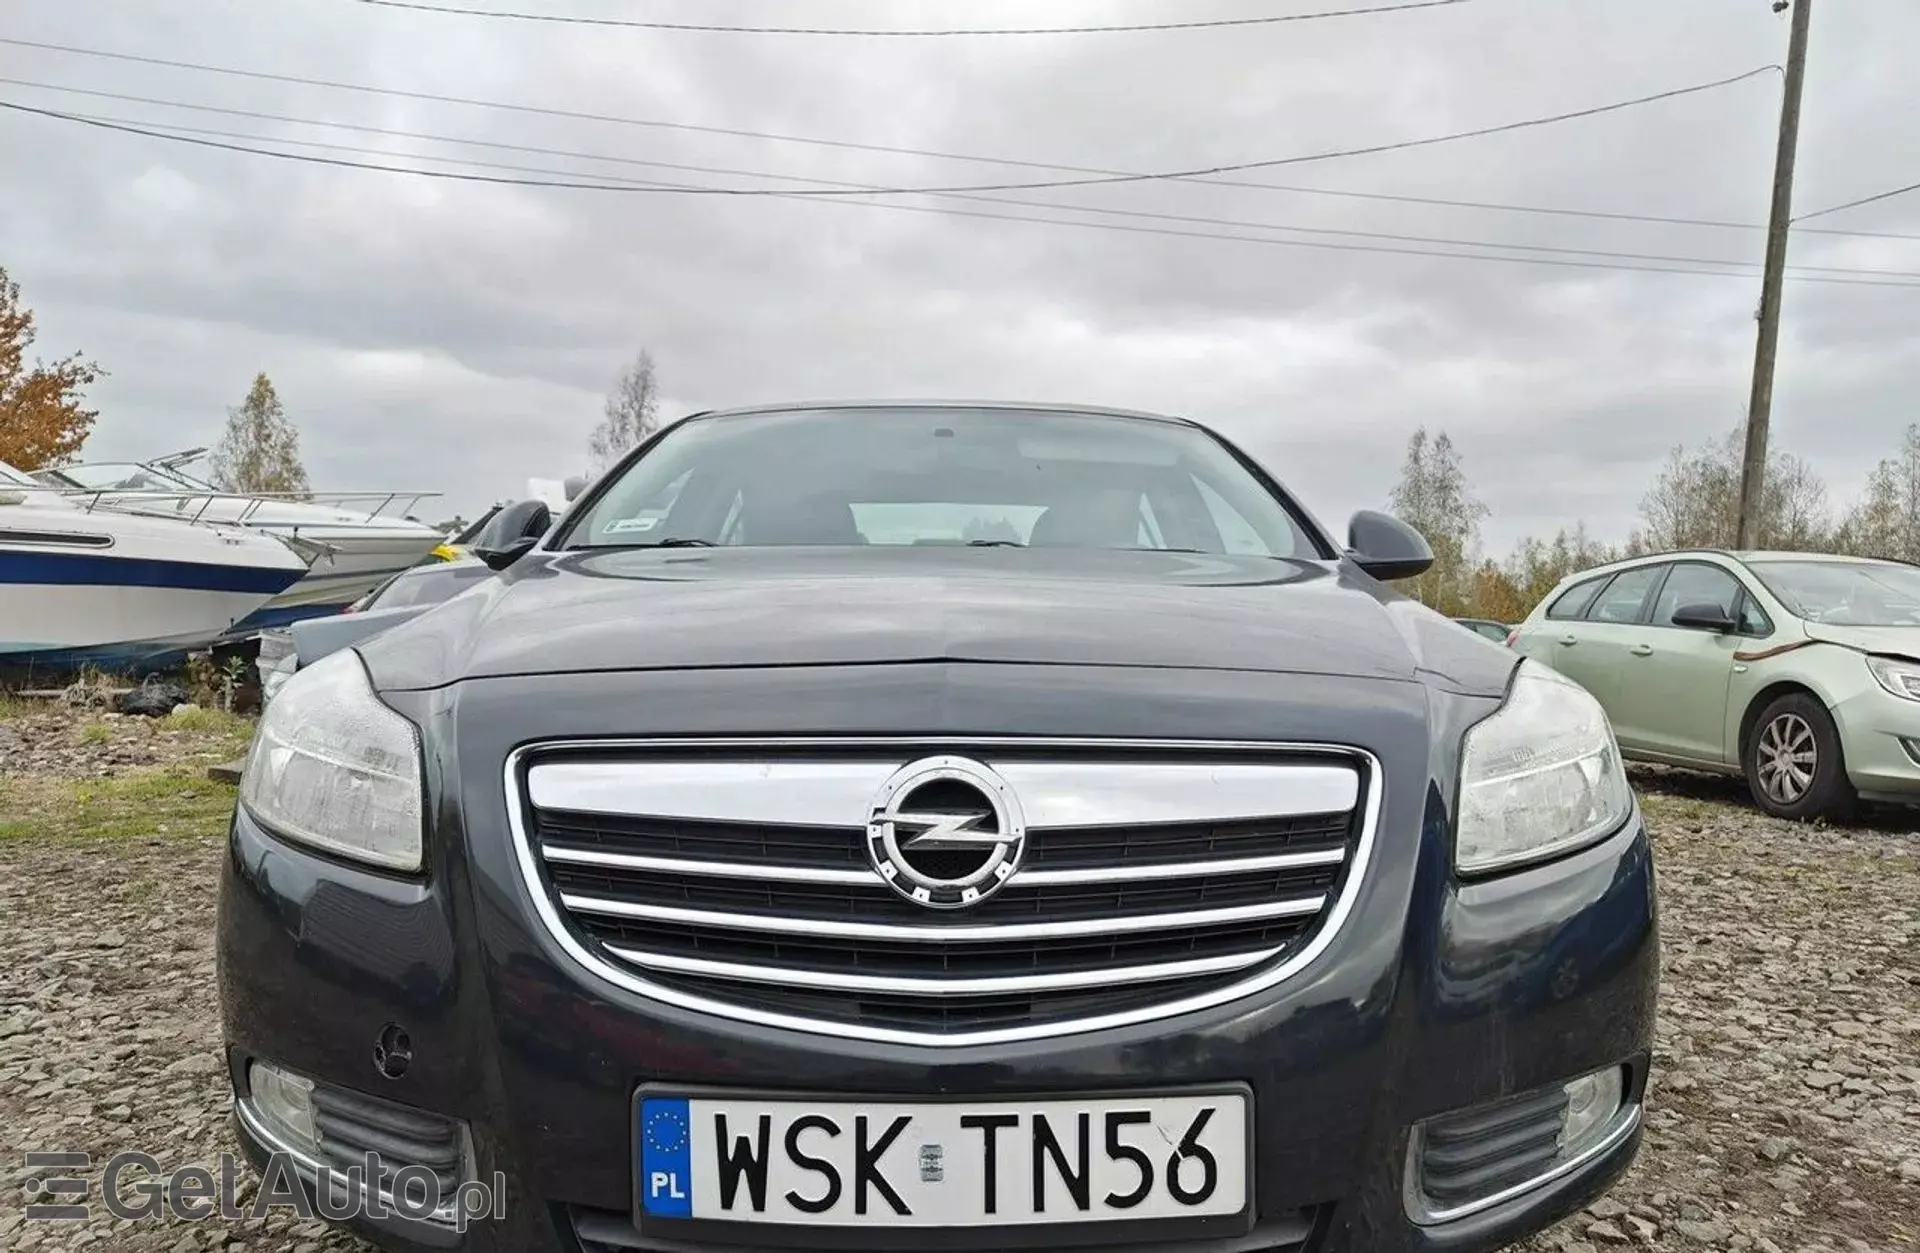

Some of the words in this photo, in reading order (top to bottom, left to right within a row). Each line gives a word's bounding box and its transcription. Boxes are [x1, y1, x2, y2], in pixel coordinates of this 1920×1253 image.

[651, 1172, 685, 1198] PL
[714, 1114, 913, 1216] WSK
[960, 1108, 1217, 1214] TN56
